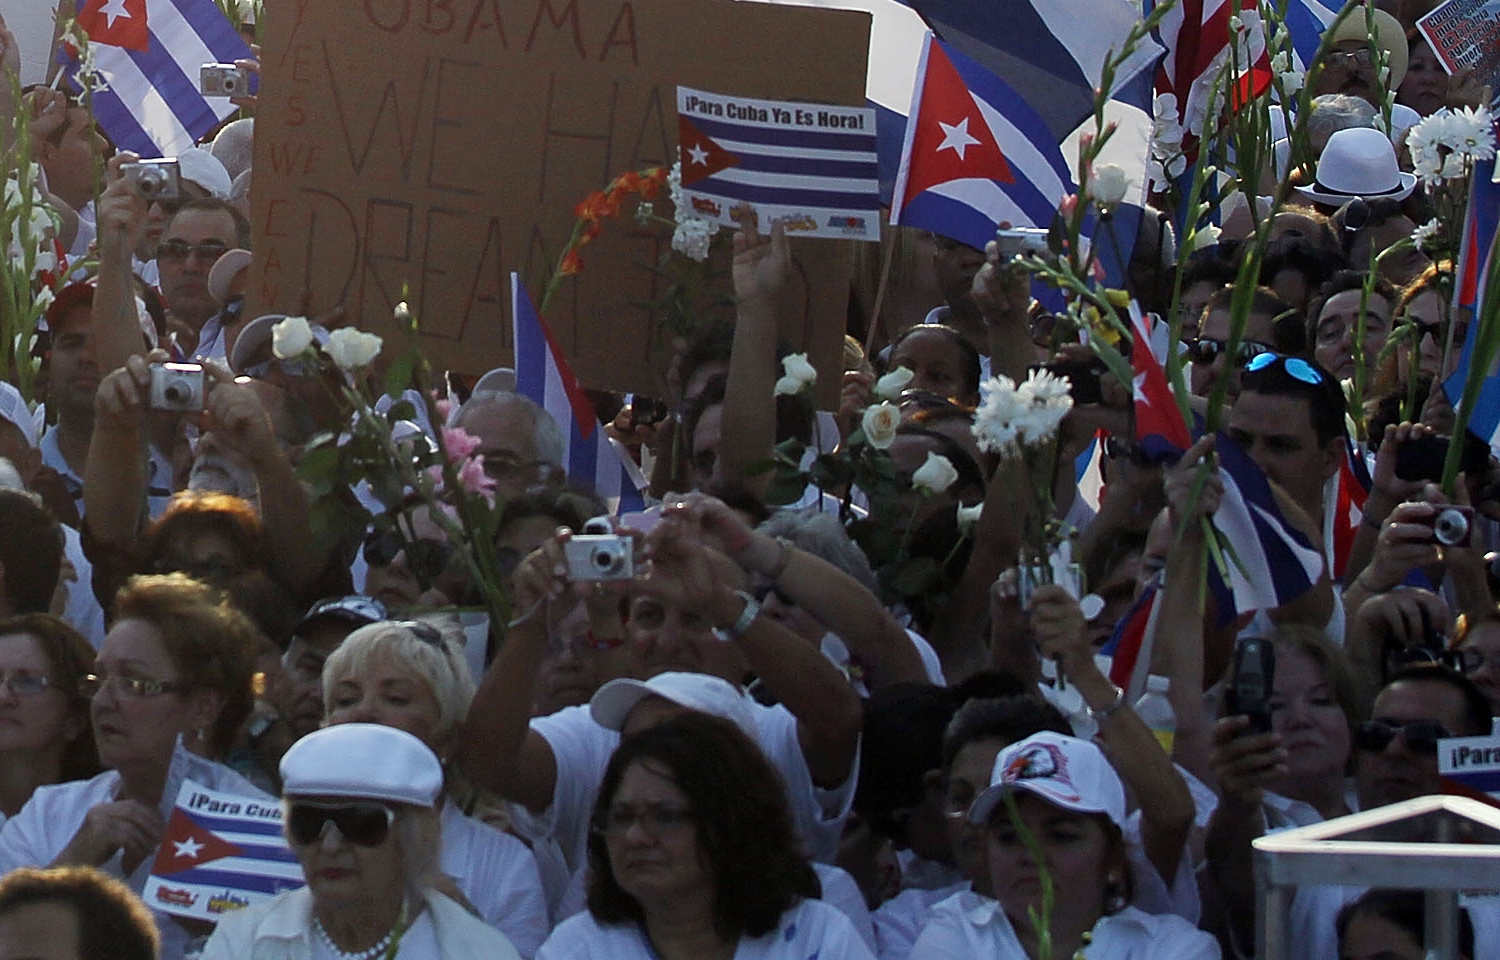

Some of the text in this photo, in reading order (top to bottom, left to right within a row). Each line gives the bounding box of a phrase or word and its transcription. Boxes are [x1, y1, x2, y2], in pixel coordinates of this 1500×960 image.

[1434, 13, 1466, 38] muere
[1440, 35, 1456, 49] de
[321, 38, 483, 197] WE
[685, 95, 864, 129] ¡Para Cuba Ya Es Hora!
[188, 792, 284, 820] ¡Para Cub
